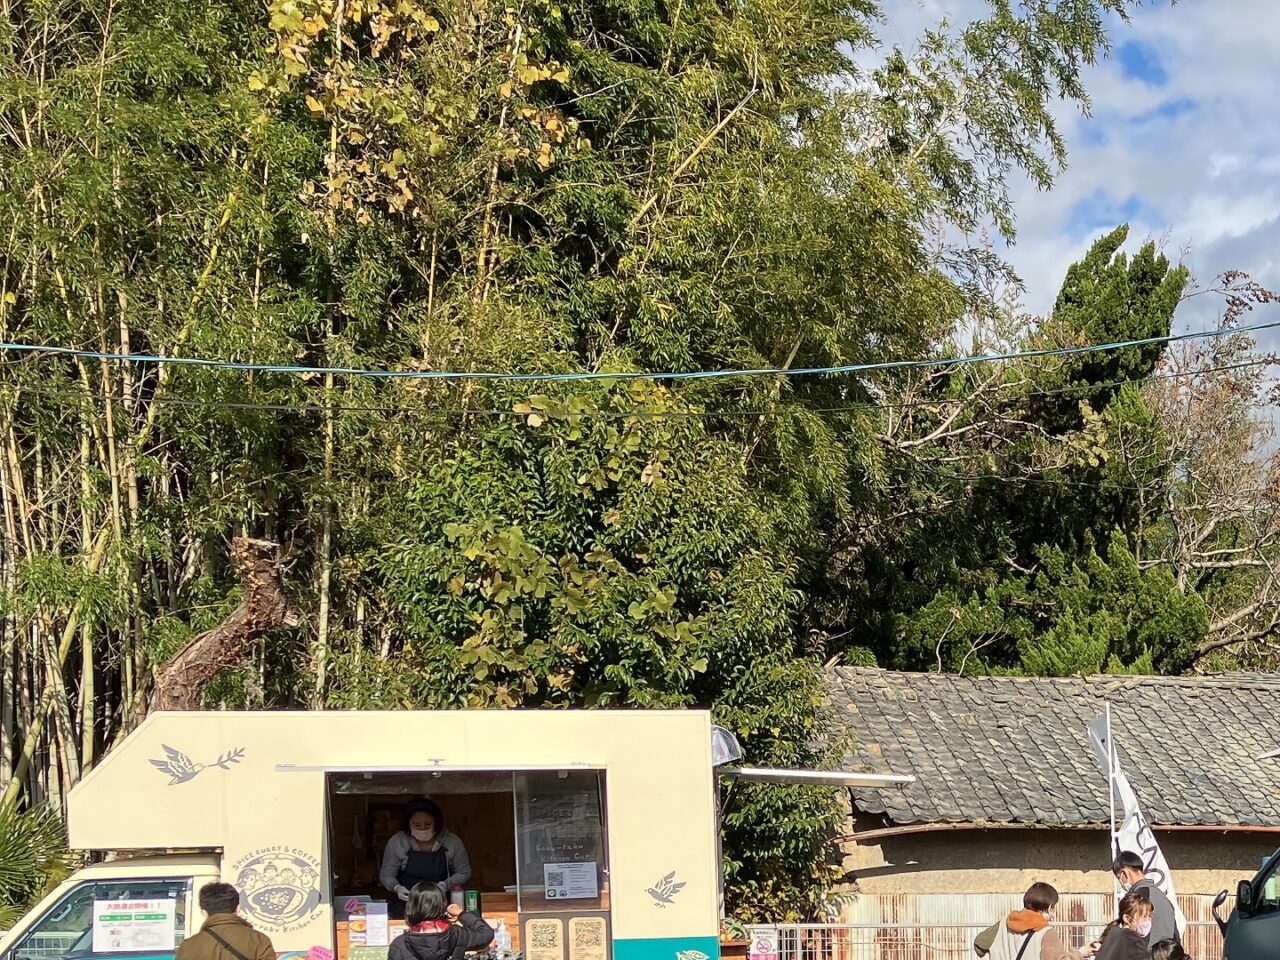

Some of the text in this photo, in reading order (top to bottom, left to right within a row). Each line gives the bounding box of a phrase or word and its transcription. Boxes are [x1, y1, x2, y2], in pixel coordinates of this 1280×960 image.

[232, 852, 254, 870] SPICE
[255, 845, 282, 855] CURRY
[291, 848, 321, 868] COFFEE
